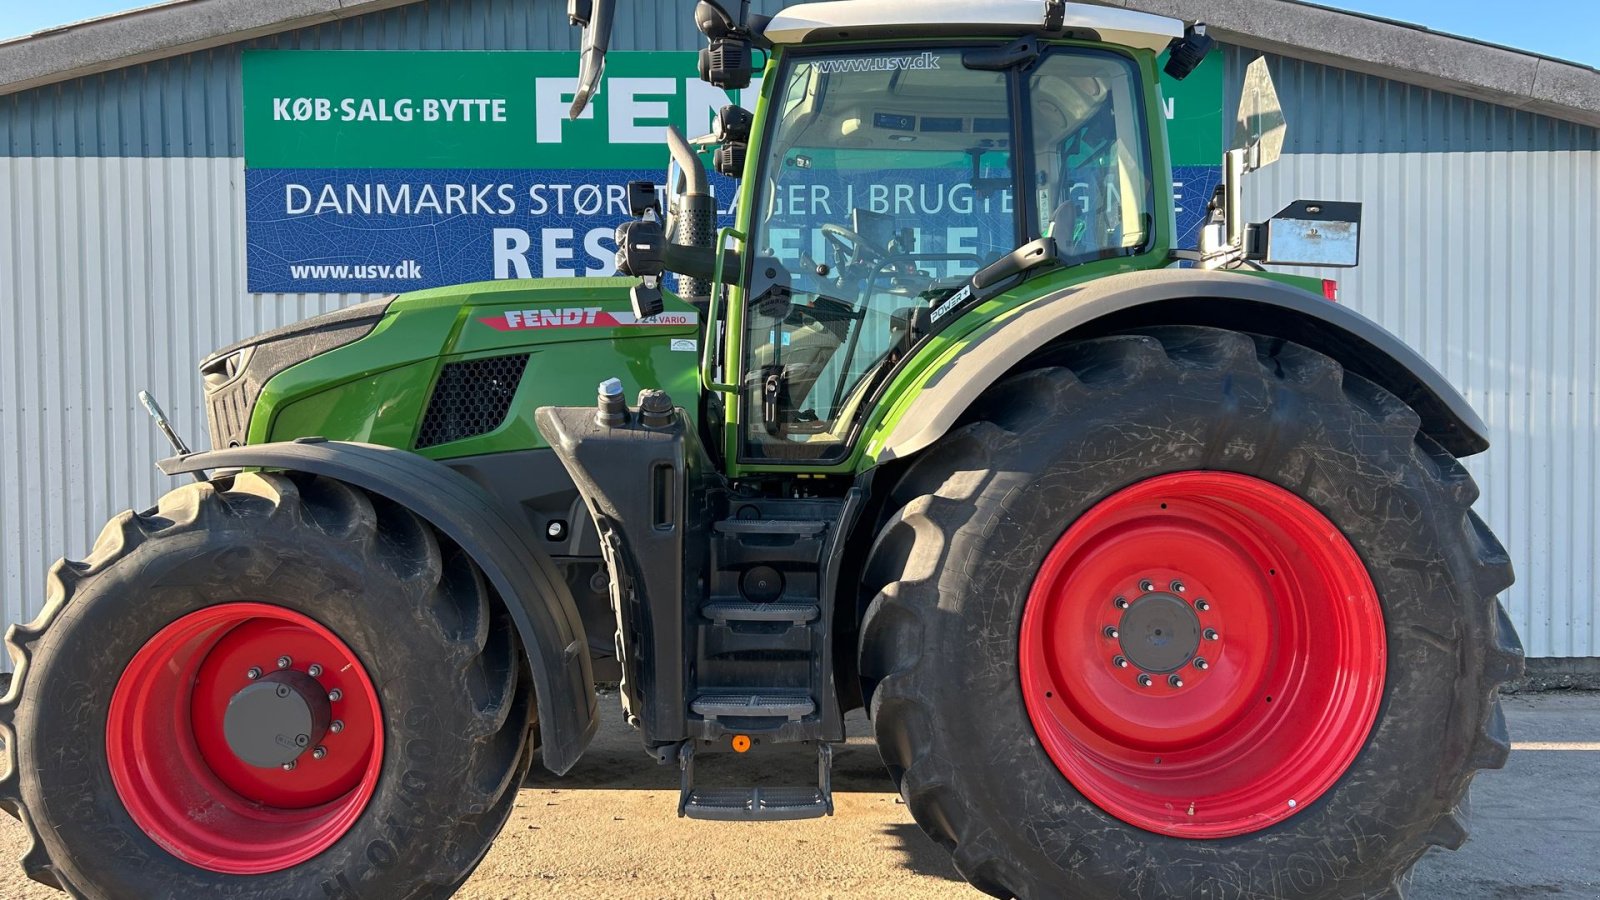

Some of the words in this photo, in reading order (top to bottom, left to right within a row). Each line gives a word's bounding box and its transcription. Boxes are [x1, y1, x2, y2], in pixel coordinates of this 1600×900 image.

[810, 52, 940, 73] www.usv.dk
[286, 183, 516, 215] DANMARKS
[291, 260, 422, 279] www.usv.dk
[504, 307, 602, 328] FENDT
[659, 316, 687, 324] VARIO
